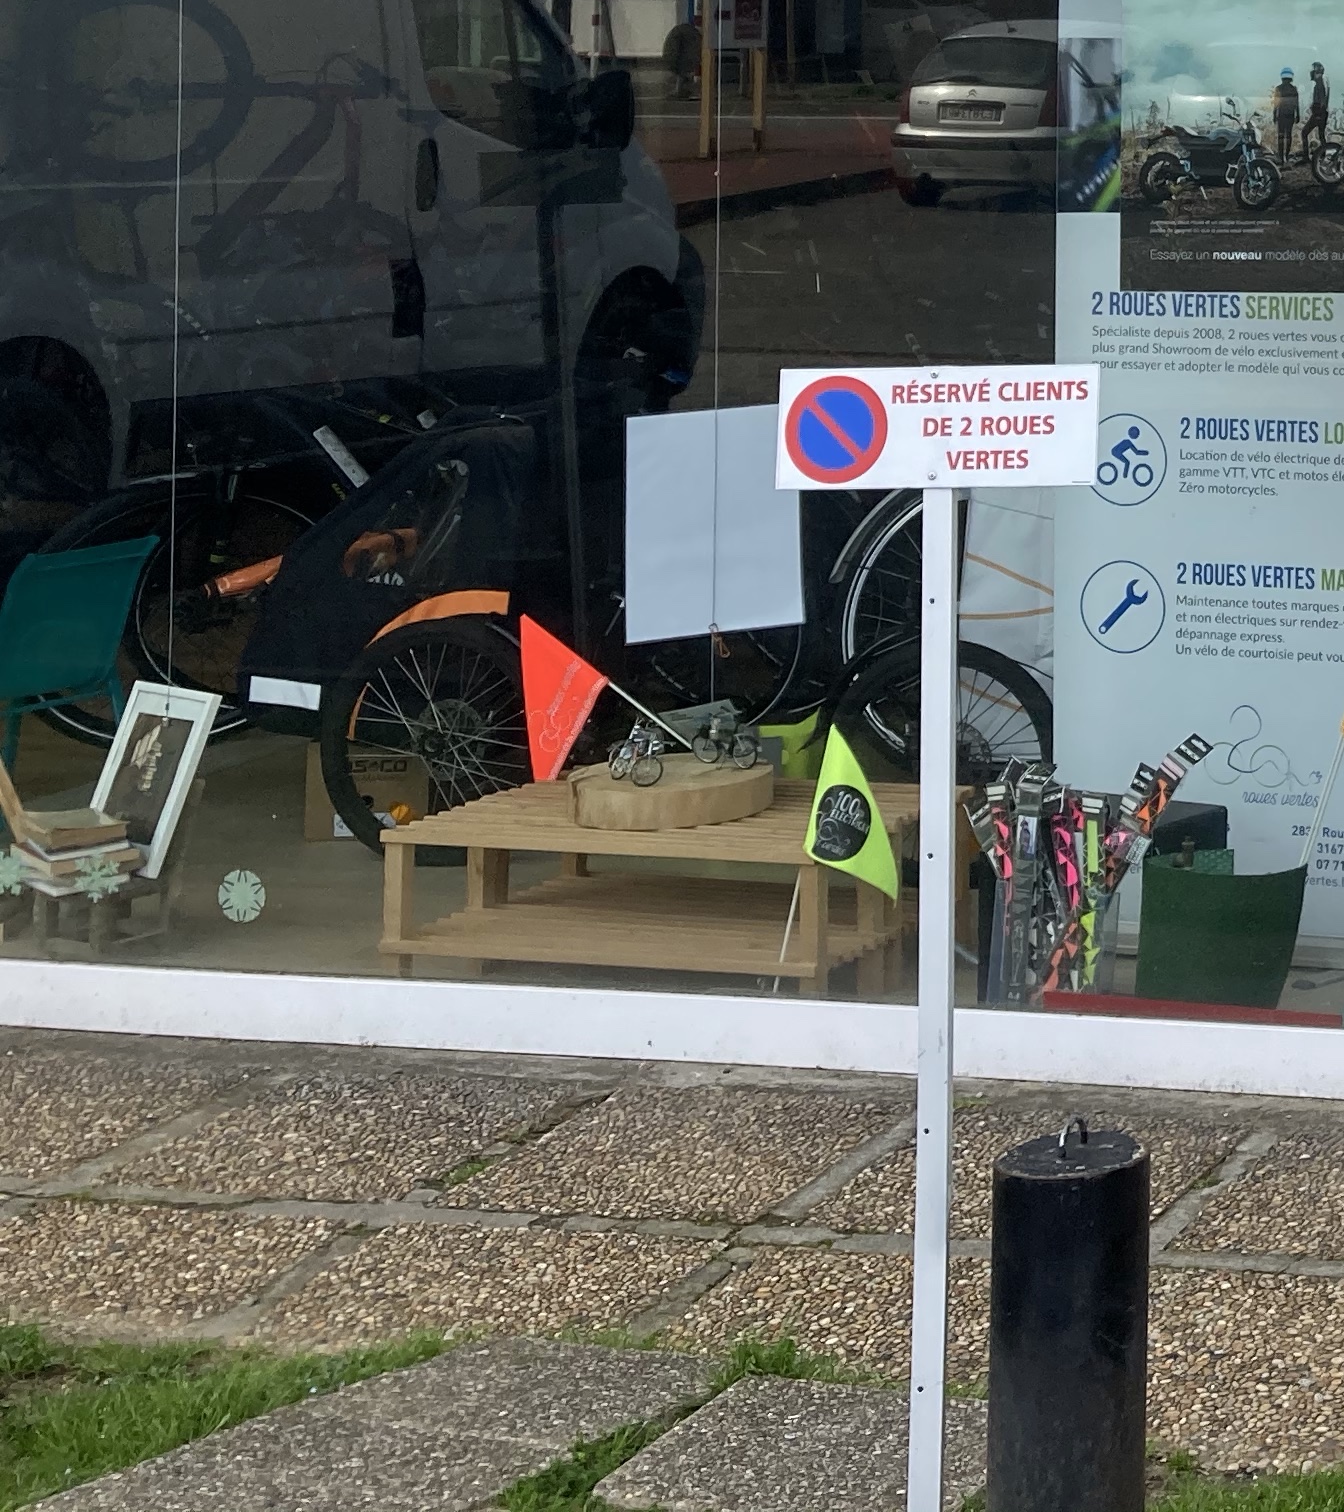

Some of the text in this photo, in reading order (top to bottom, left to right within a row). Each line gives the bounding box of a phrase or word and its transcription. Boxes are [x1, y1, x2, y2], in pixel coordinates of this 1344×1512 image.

[1150, 249, 1193, 263] Essayez
[1196, 250, 1210, 261] un
[1212, 251, 1263, 261] nouveau
[1265, 249, 1306, 261] modèle
[1308, 249, 1328, 261] dès
[1091, 291, 1334, 321] 2 ROUES VERTES SERVICES
[1092, 325, 1151, 338] Spécialiste
[1153, 326, 1190, 340] depuis
[1192, 328, 1225, 341] 2008,
[1228, 328, 1236, 340] 2
[1238, 331, 1269, 341] roues
[1272, 331, 1308, 342] vertes
[1310, 333, 1337, 343] vous
[1092, 342, 1116, 355] plus
[1118, 343, 1150, 356] grand
[1152, 342, 1212, 356] Showroom
[1214, 345, 1229, 356] de
[1231, 345, 1255, 357] vélo
[1258, 346, 1339, 360] exclusivement
[1121, 360, 1161, 372] essayer
[1164, 360, 1176, 371] et
[1177, 361, 1222, 374] adopter
[1224, 361, 1235, 373] le
[1238, 361, 1279, 374] modèle
[1282, 363, 1301, 376] qui
[1303, 366, 1330, 376] vous
[891, 378, 1089, 405] RÉSERVÉ CLIENTS
[922, 415, 1055, 437] DE 2 ROUES
[1180, 416, 1191, 440] 2
[1195, 417, 1250, 441] ROUES
[1254, 419, 1319, 444] VERTES
[946, 449, 1029, 471] VERTES
[1179, 449, 1228, 462] Location
[1230, 450, 1245, 462] de
[1247, 451, 1271, 463] vélo
[1274, 452, 1331, 468] électrique
[1179, 468, 1220, 479] gamme
[1222, 467, 1249, 480] VTT,
[1251, 468, 1276, 480] VTC
[1278, 470, 1291, 481] et
[1293, 471, 1329, 482] motos
[1178, 481, 1279, 497] Zéro motorcycles.
[1176, 562, 1315, 590] 2 ROUES VERTES
[1175, 594, 1340, 614] Maintenance toutes marques
[1175, 612, 1188, 623] et
[1190, 614, 1212, 624] non
[1214, 613, 1277, 628] électriques
[1279, 617, 1297, 628] sur
[1175, 628, 1286, 644] dépannage express.
[1175, 644, 1192, 656] Un
[1194, 645, 1218, 657] vélo
[1221, 645, 1236, 658] de
[1238, 648, 1294, 660] courtoisie
[1297, 651, 1323, 663] peut
[1242, 791, 1320, 808] roues vertes
[1316, 859, 1330, 870] 07
[1333, 860, 1344, 871] 71
